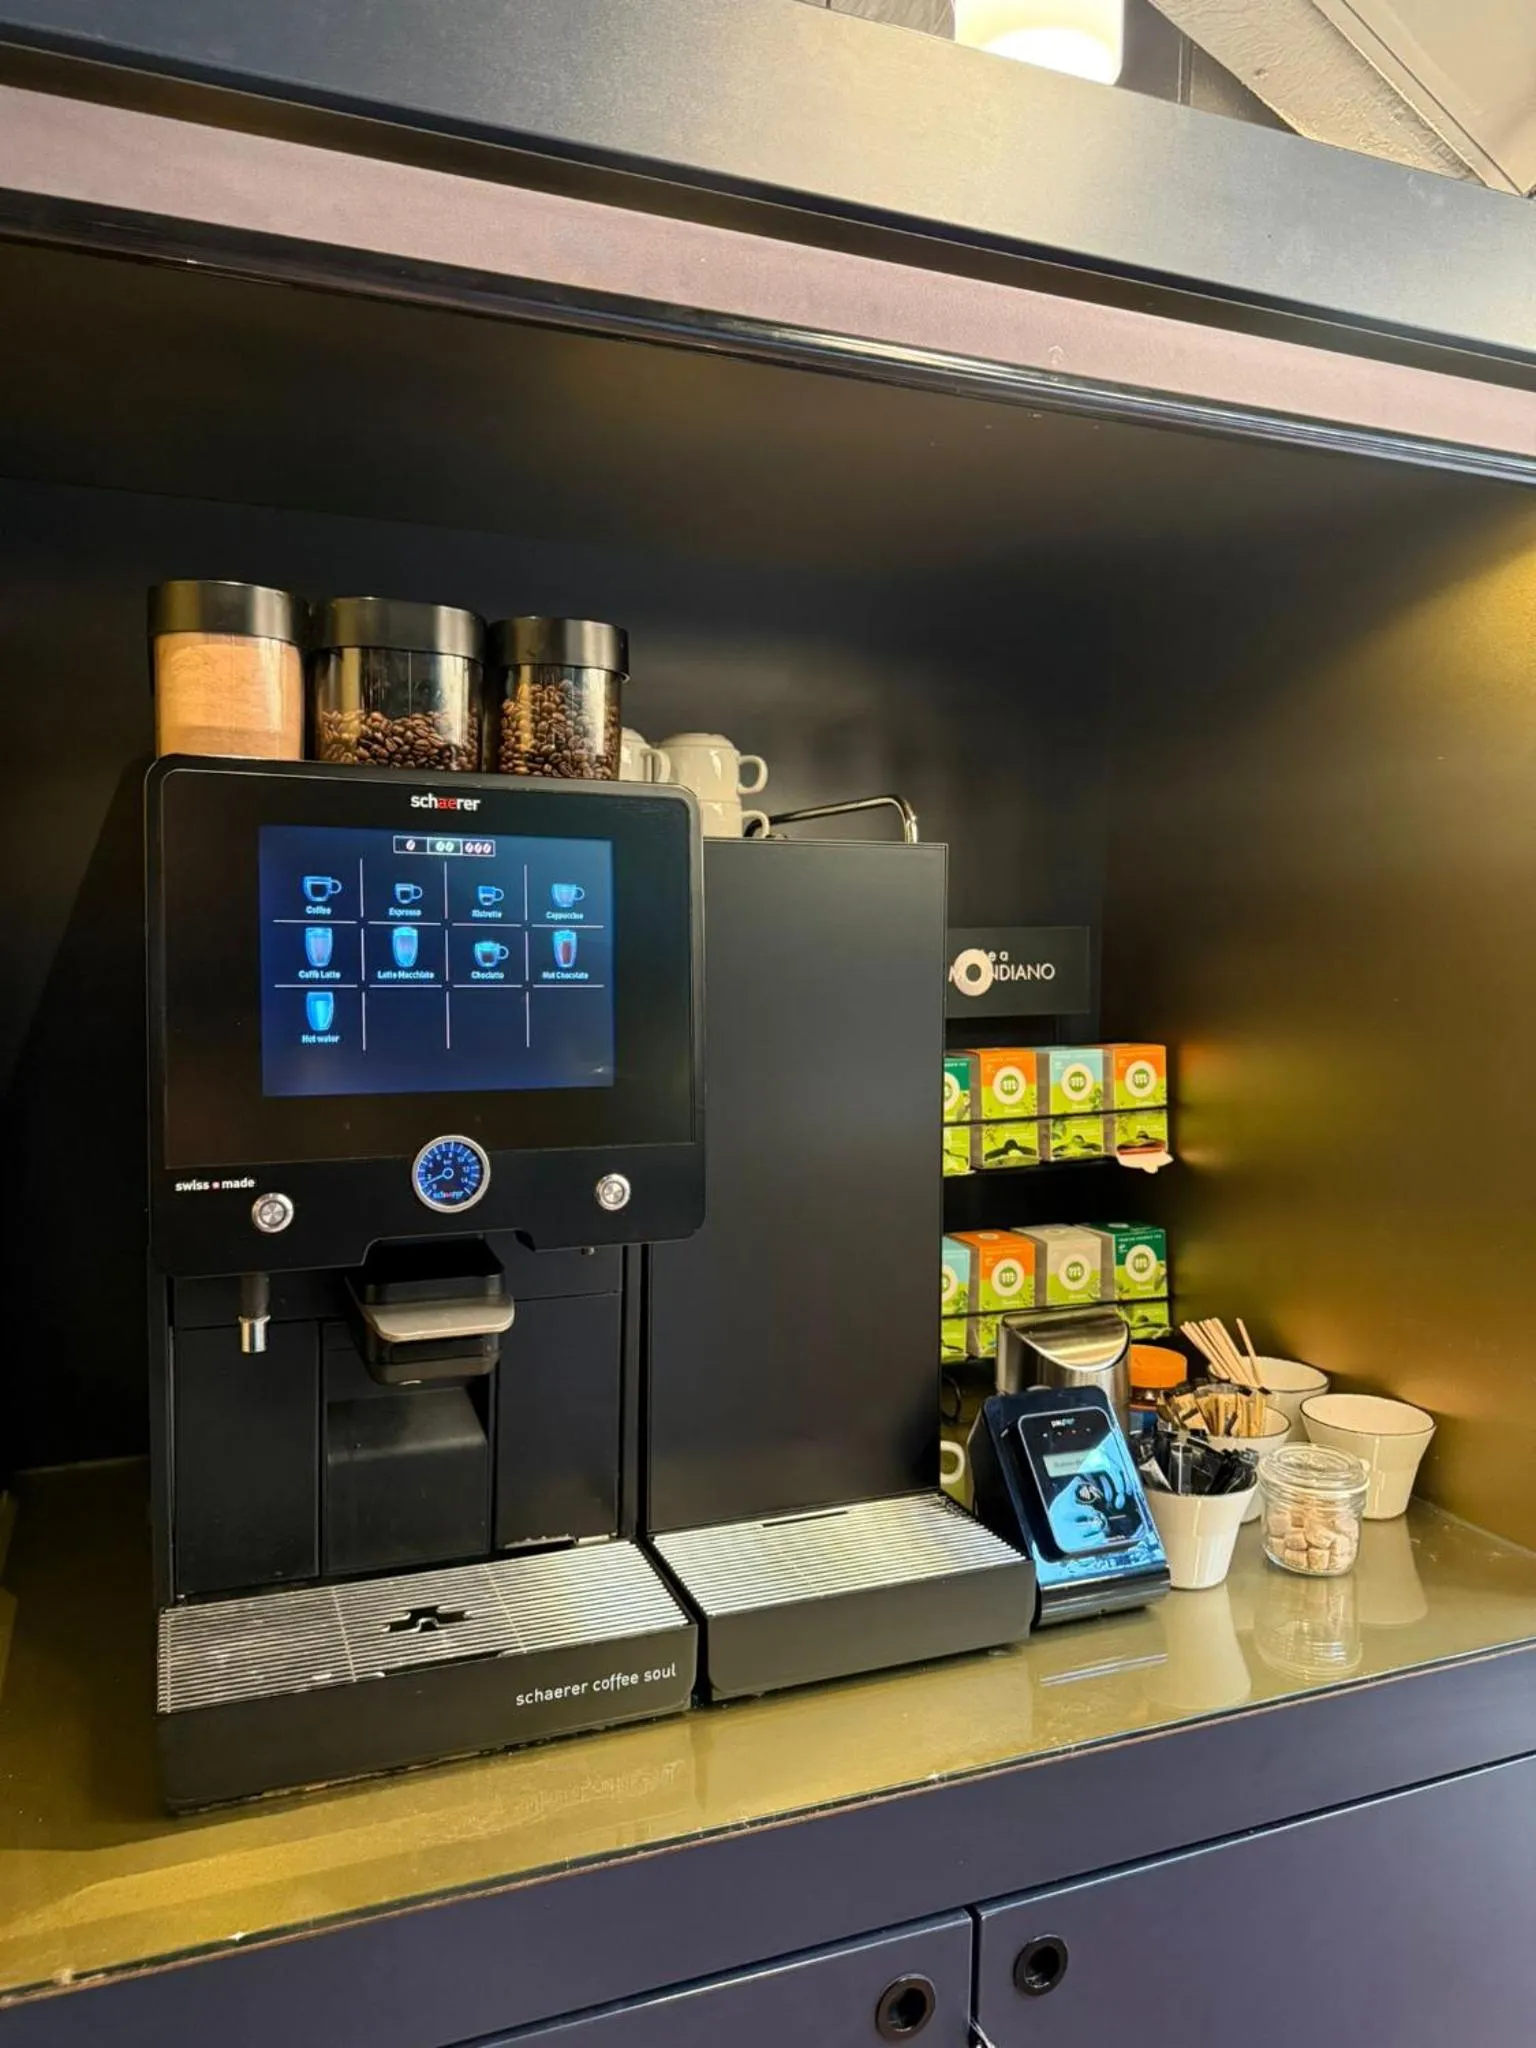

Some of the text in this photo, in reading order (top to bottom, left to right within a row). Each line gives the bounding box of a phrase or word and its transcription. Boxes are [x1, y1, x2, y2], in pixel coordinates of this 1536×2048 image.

[410, 792, 481, 811] schaerer
[305, 906, 332, 915] Coffee
[388, 908, 422, 917] Espresso
[545, 910, 584, 920] Cappuccino
[320, 970, 341, 979] Latte
[377, 970, 435, 980] Latte Macchiato
[301, 1035, 339, 1043] Hot water
[175, 1177, 255, 1191] swiss made
[515, 1662, 677, 1706] schaerer coffee soul
